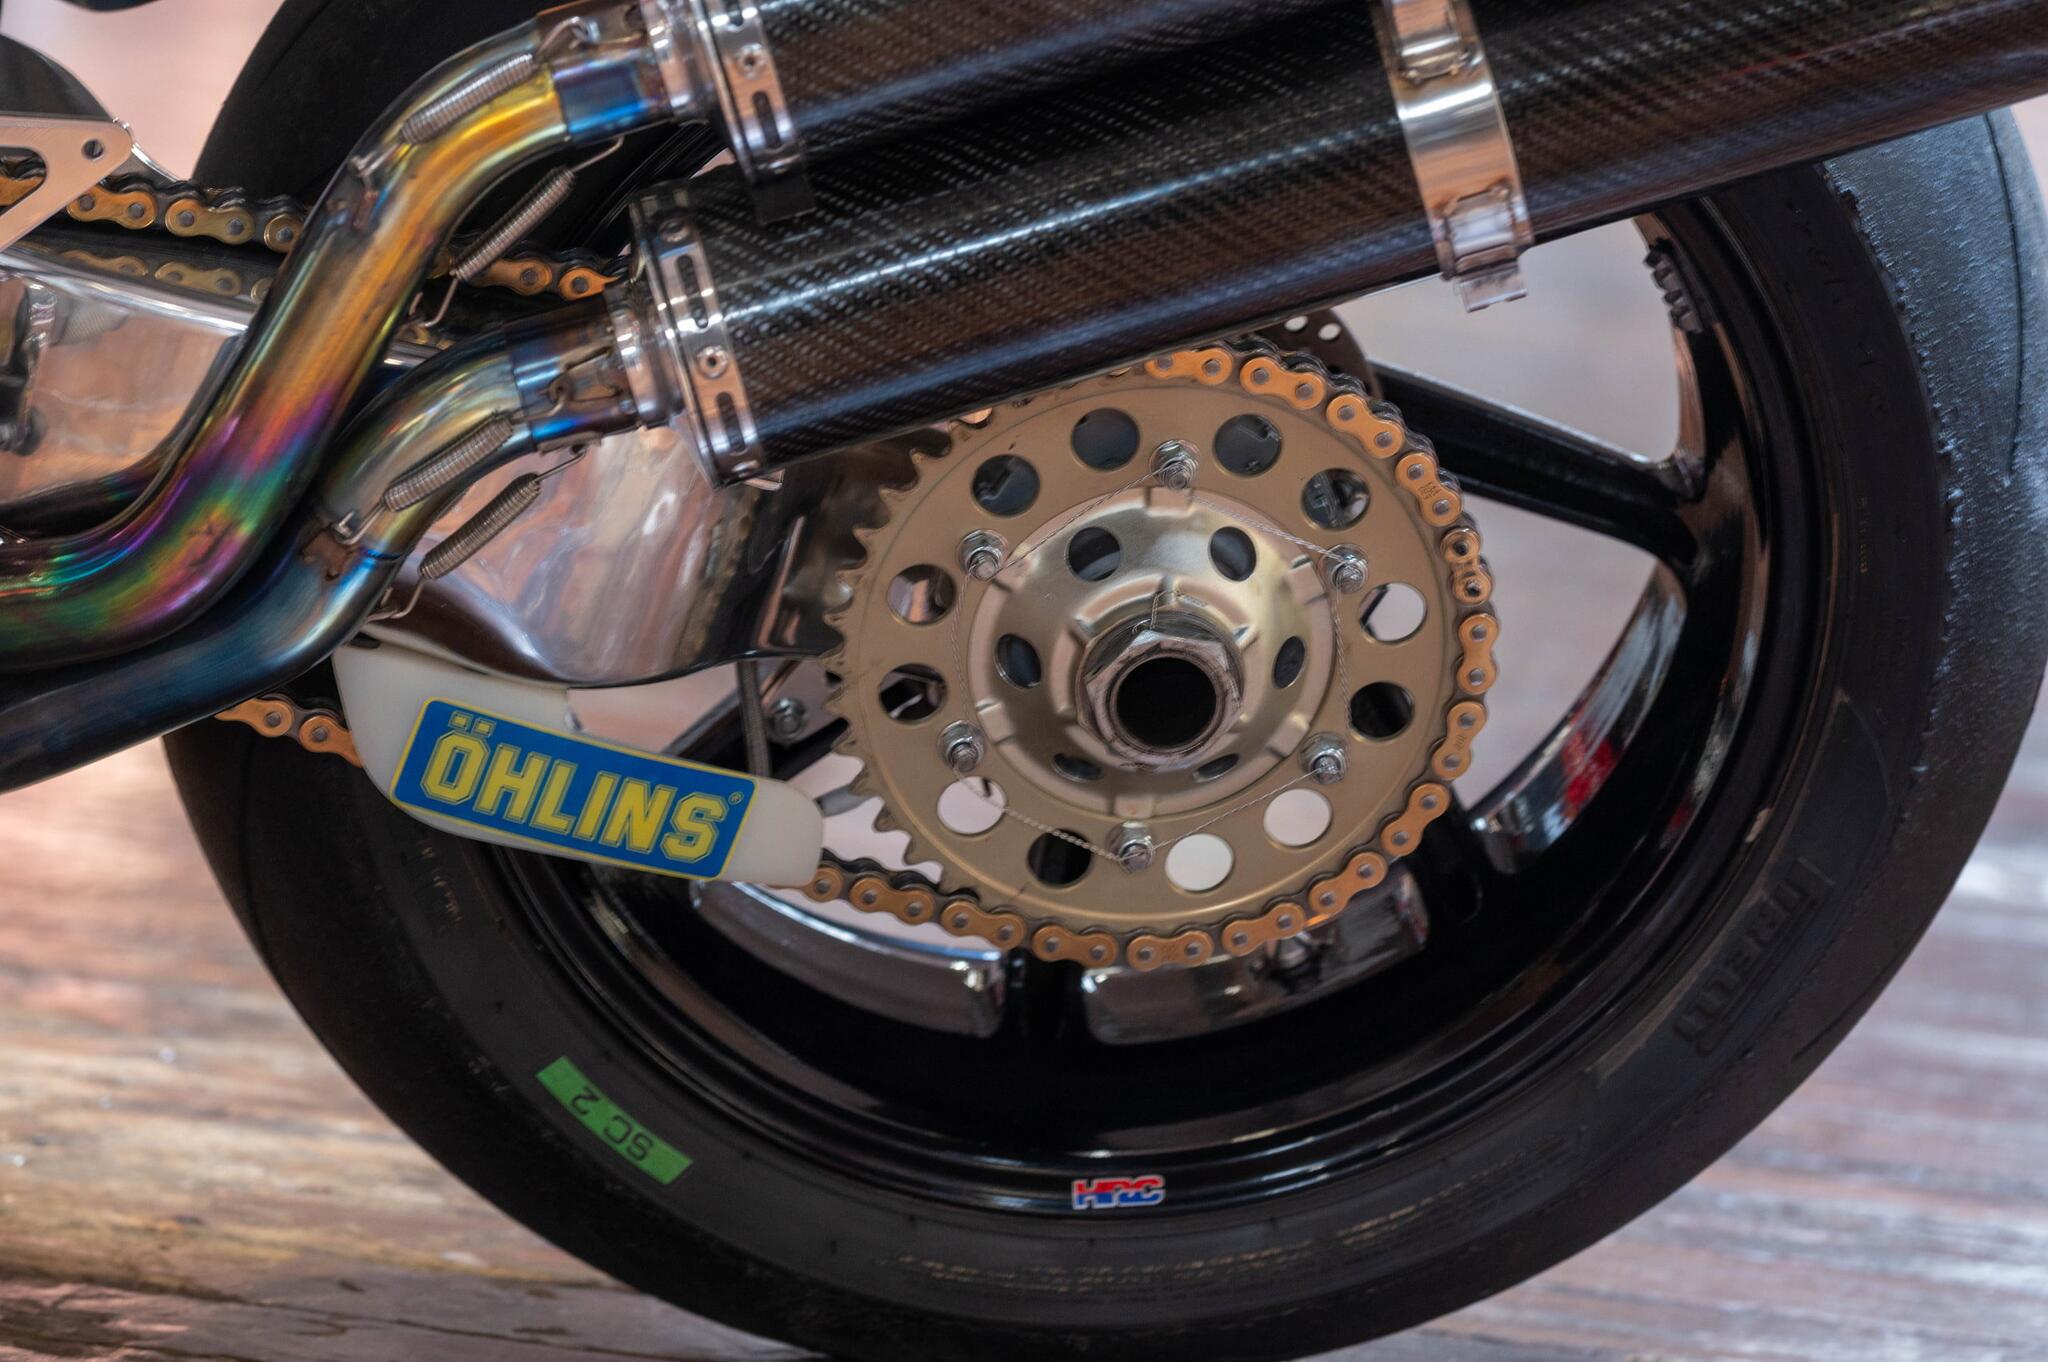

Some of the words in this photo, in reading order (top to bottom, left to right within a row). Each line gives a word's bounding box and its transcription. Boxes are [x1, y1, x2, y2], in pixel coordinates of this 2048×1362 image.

[571, 1086, 599, 1115] 2
[603, 1115, 654, 1161] SC
[1072, 1175, 1165, 1210] HRC
